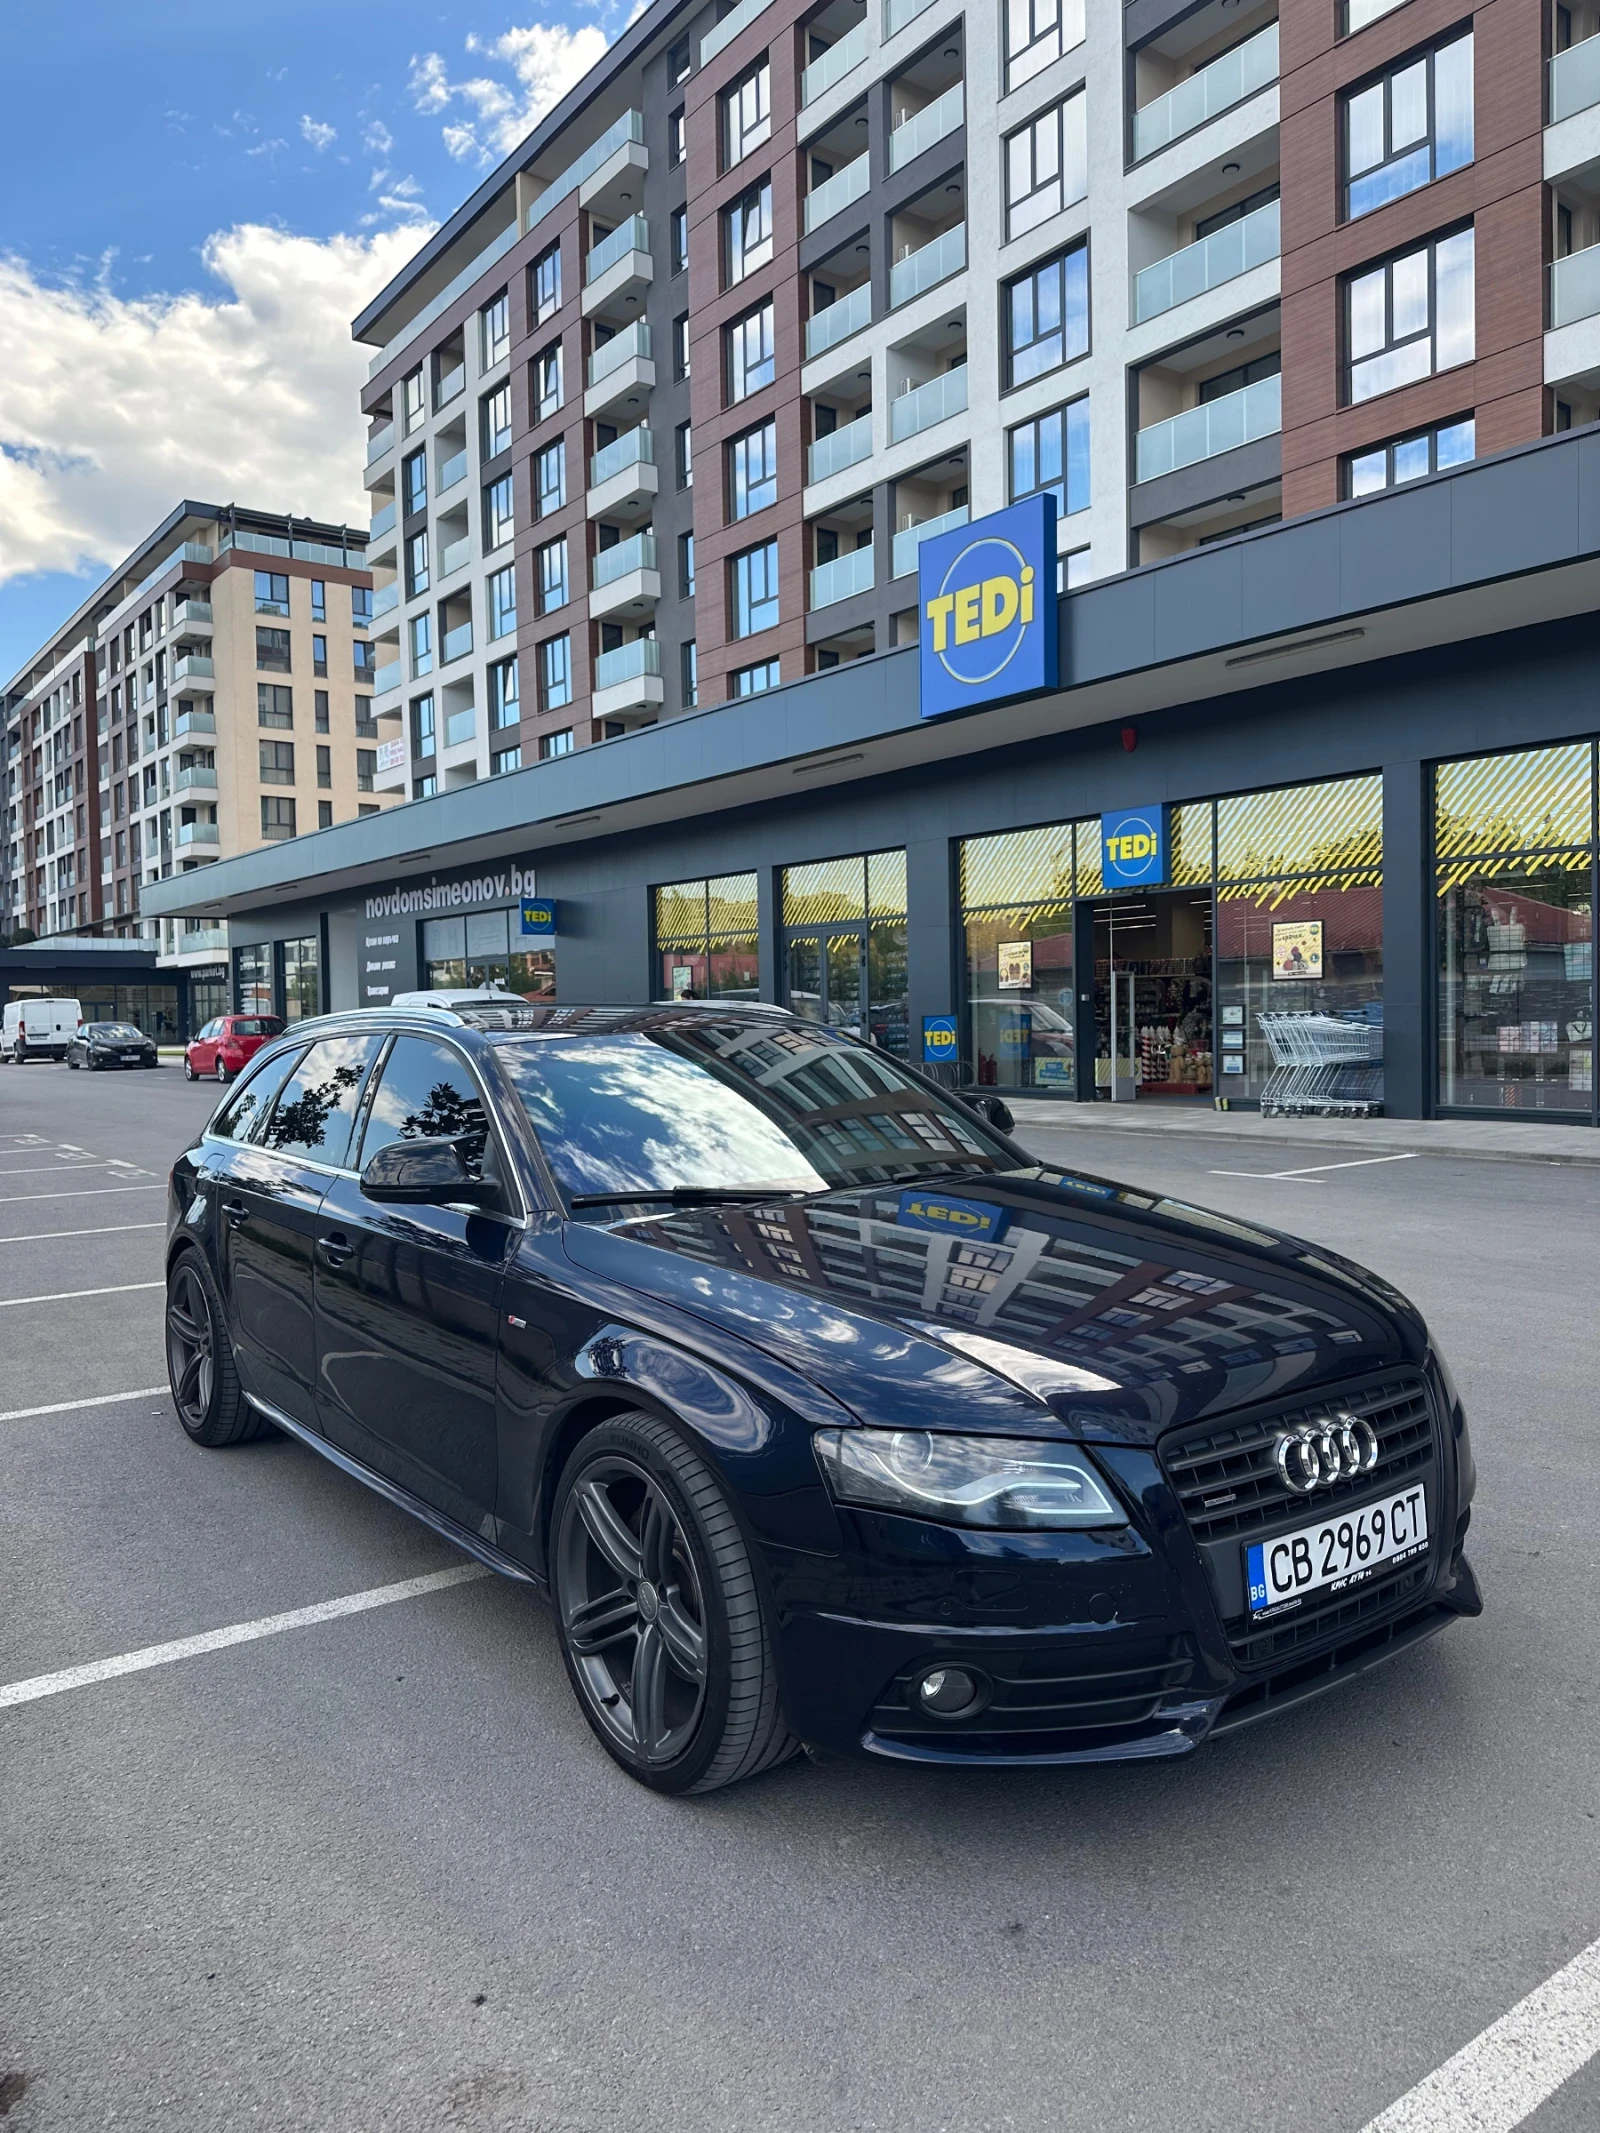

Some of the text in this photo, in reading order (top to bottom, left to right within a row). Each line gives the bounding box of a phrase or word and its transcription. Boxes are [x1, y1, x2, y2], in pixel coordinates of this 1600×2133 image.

[927, 565, 1035, 654] TEDi
[1106, 832, 1157, 861] TEDi
[365, 863, 537, 919] novdomsimeonov.bg
[523, 910, 552, 923] TEDi
[190, 964, 225, 981] www.parket.bg
[925, 1030, 956, 1047] TEDi
[1270, 1491, 1420, 1593] CB 2969 CT
[1250, 1583, 1265, 1600] BG
